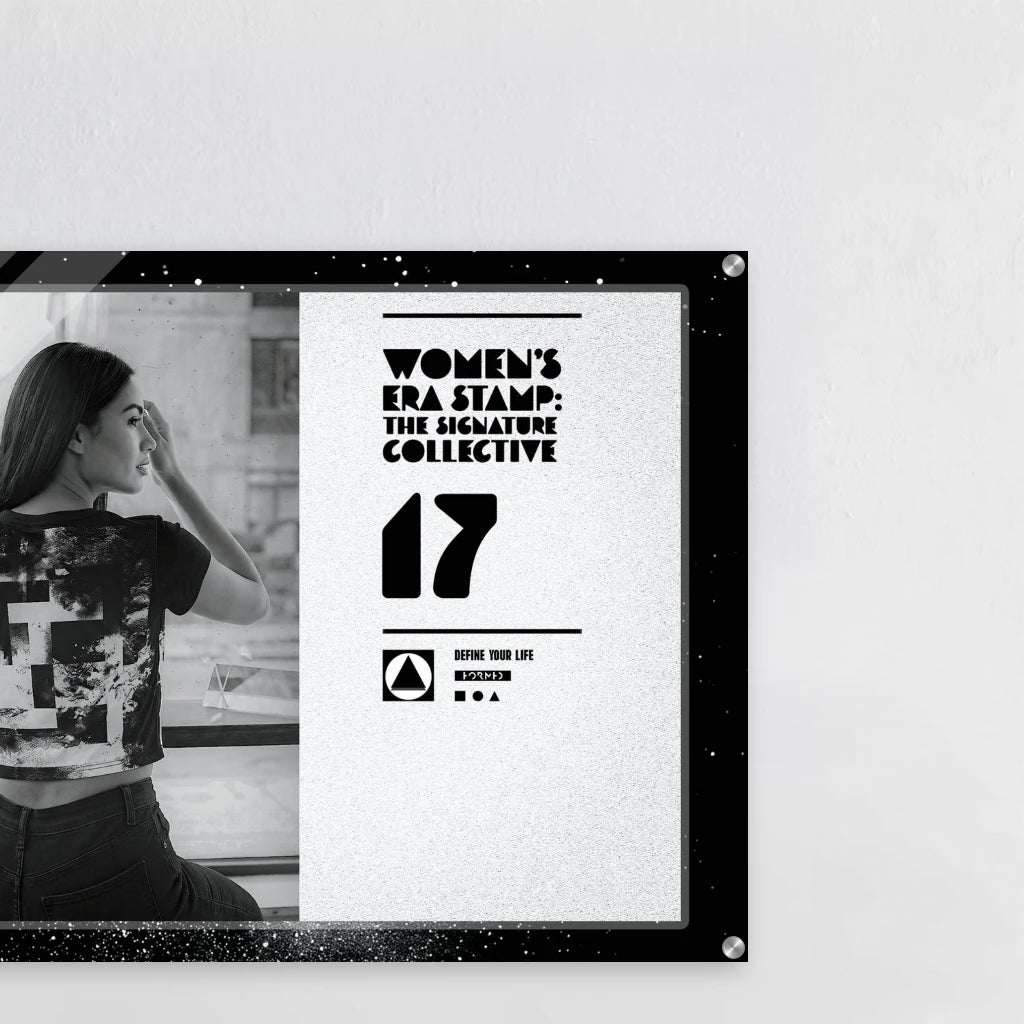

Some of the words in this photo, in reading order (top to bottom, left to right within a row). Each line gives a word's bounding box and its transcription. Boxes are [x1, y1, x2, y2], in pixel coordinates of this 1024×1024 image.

[382, 348, 562, 380] WOMEN'S
[382, 384, 443, 412] ERA
[451, 384, 563, 412] STAMP:
[382, 416, 429, 435] THE
[435, 416, 558, 435] SIGNATURE
[382, 439, 557, 464] COLLECTIVE
[381, 492, 498, 599] 17
[454, 649, 485, 661] DEFINE
[489, 649, 512, 661] YOUR
[515, 649, 534, 661] LIFE
